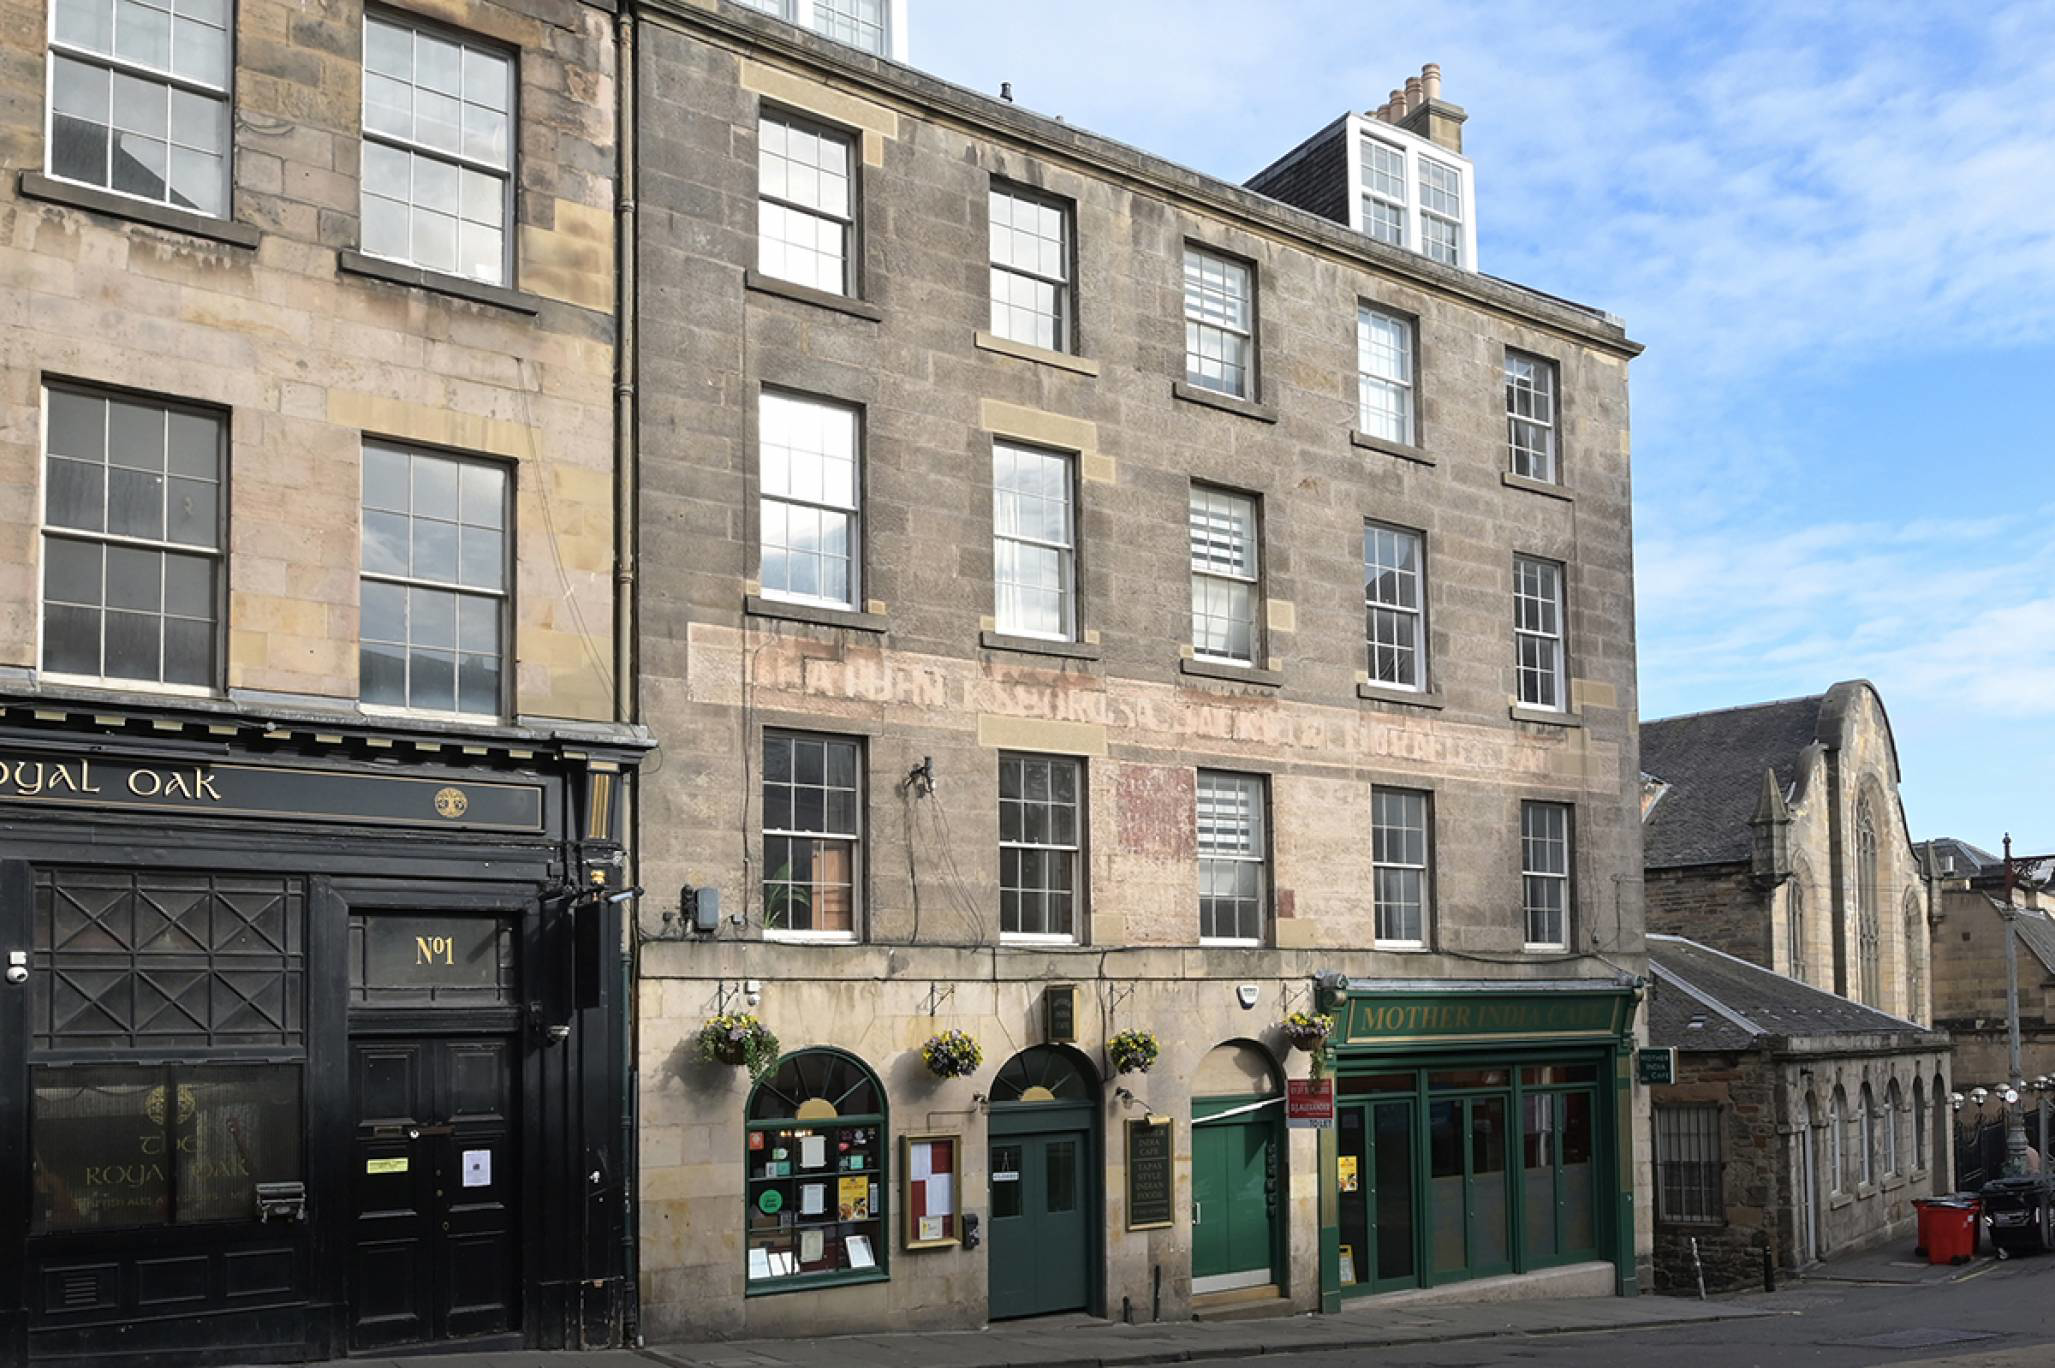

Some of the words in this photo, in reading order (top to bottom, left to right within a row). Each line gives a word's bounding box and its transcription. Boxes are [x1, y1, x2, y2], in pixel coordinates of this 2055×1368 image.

[0, 757, 100, 796] YAL
[127, 767, 222, 800] OAK
[1361, 1006, 1472, 1031] MOTHER
[1477, 1005, 1540, 1027] INDIA
[86, 1162, 165, 1188] ROYA
